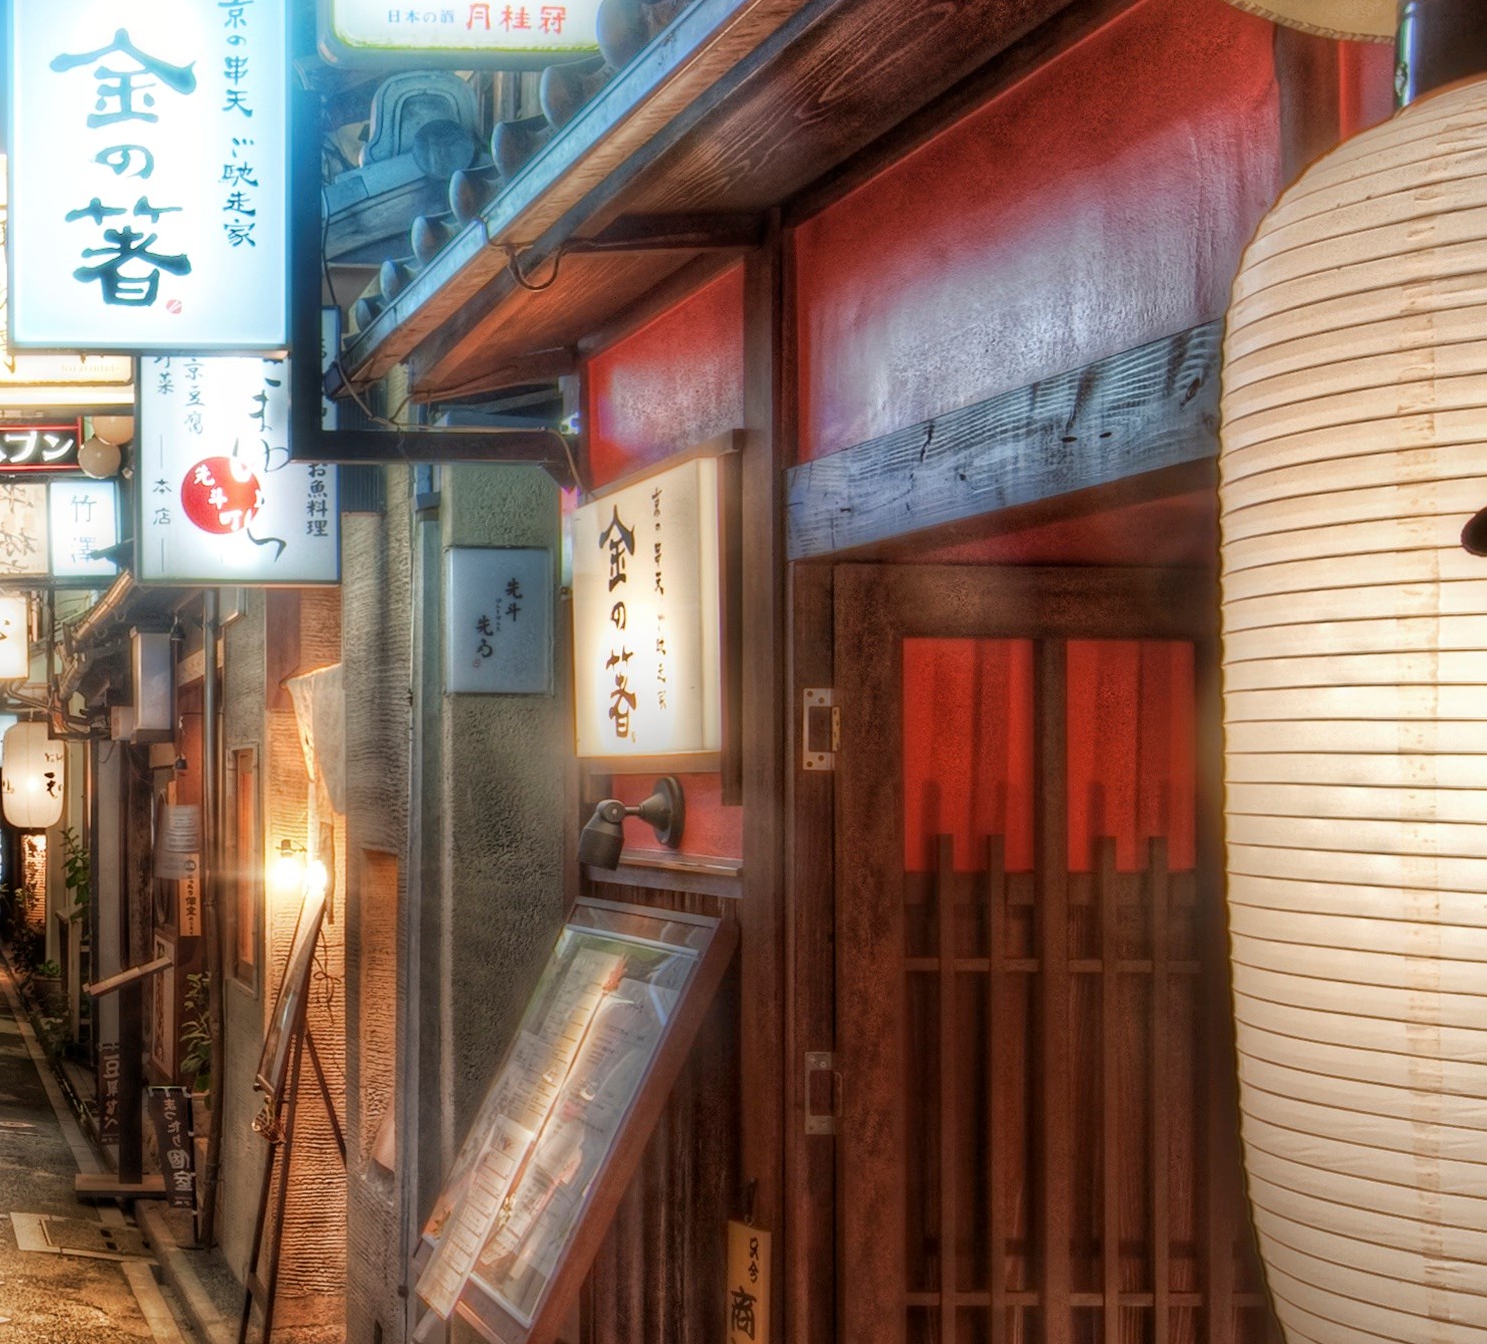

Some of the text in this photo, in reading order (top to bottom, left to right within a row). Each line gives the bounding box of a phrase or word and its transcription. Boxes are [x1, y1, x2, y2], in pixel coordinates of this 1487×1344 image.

[388, 2, 567, 35] 日本の酒 月桂冠
